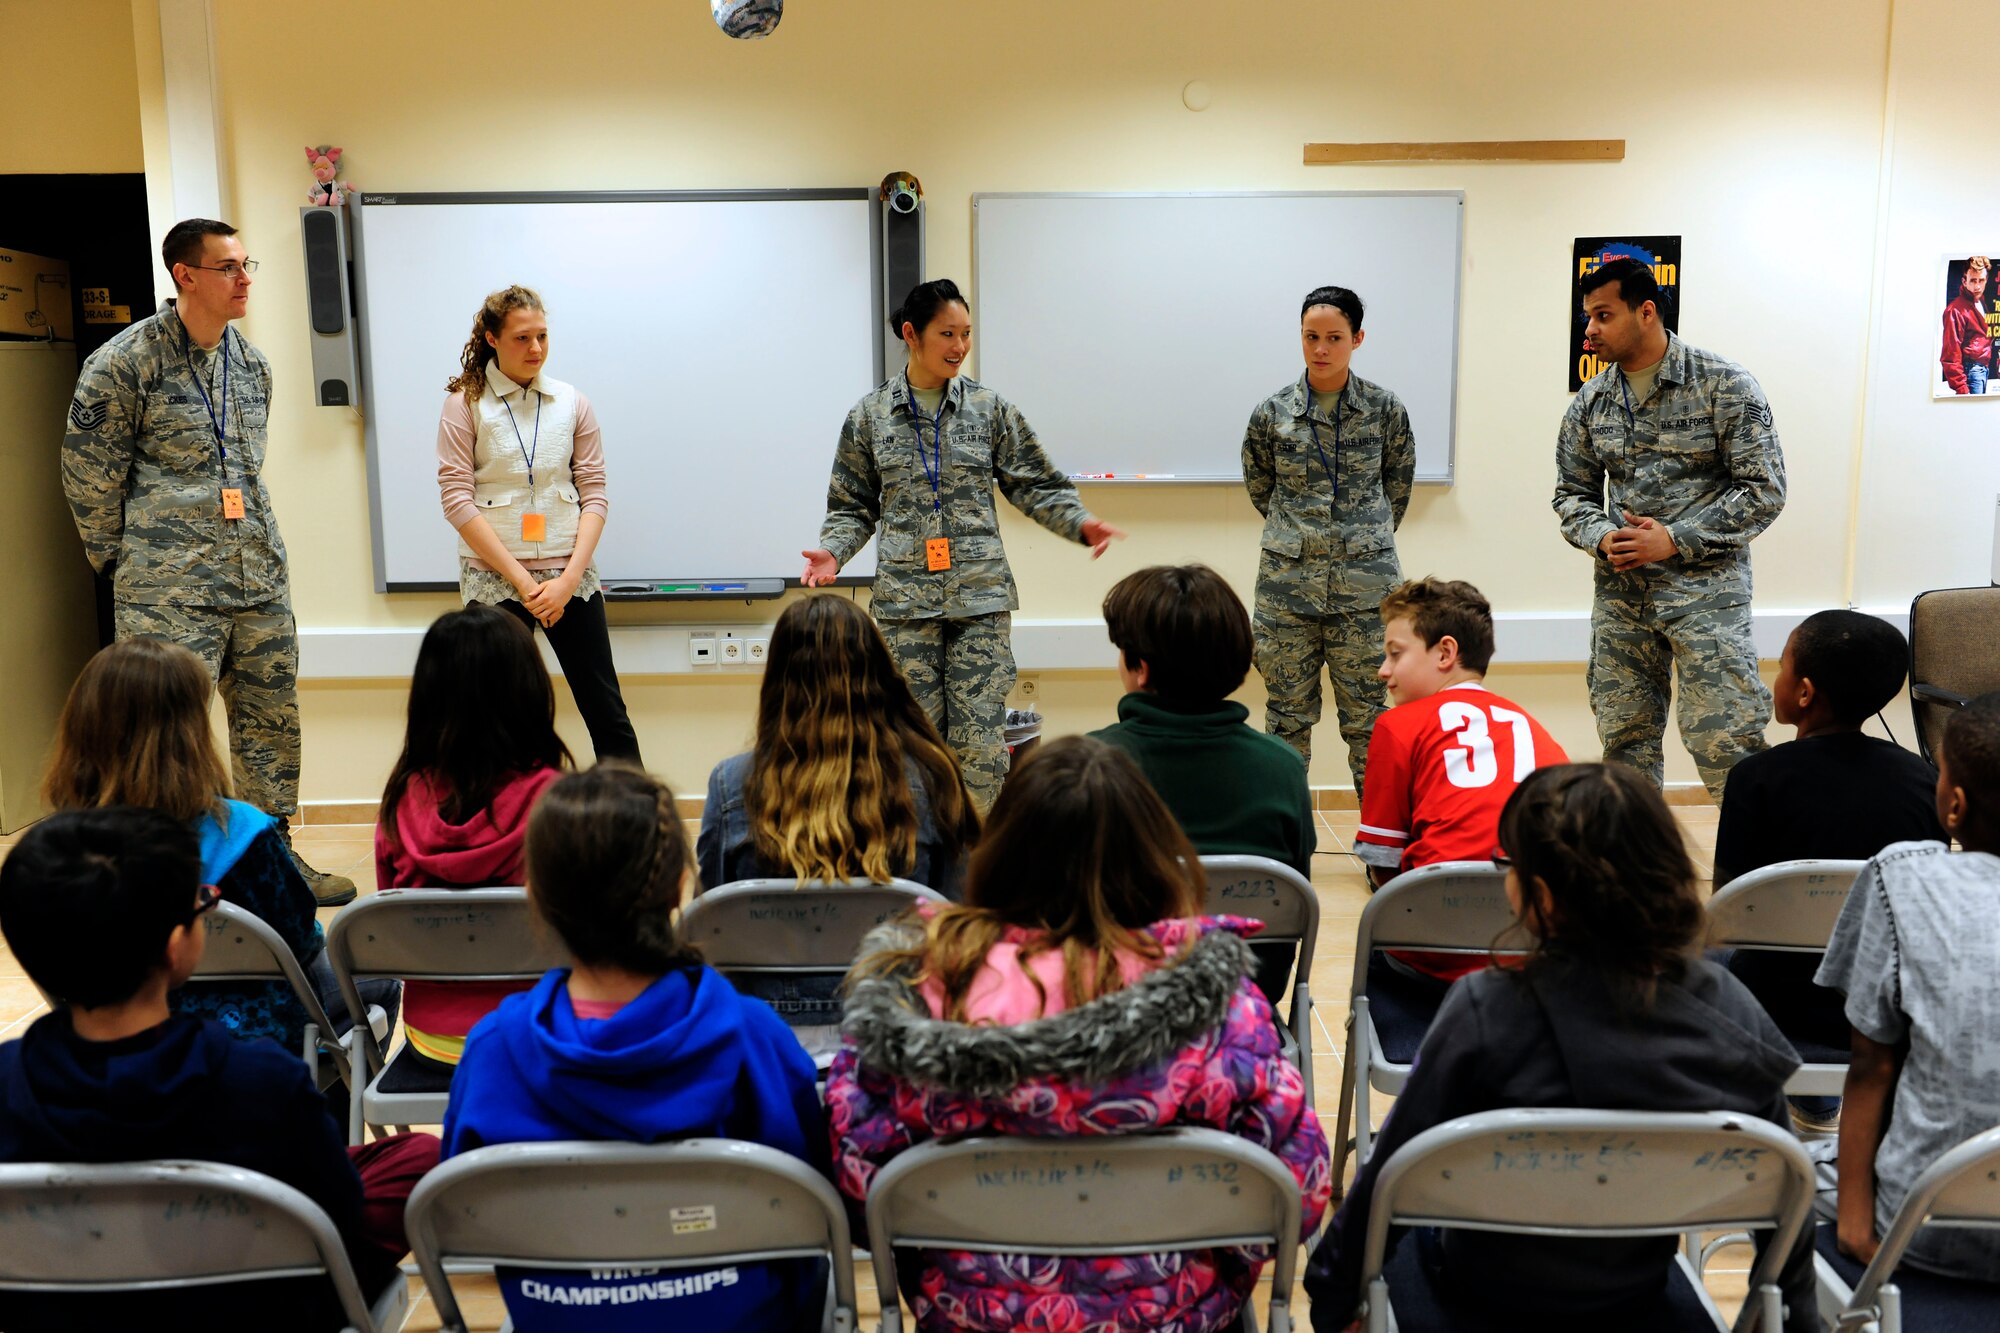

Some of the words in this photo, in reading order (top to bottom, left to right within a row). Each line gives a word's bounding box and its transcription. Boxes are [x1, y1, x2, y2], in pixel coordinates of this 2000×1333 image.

[1661, 421, 1674, 430] U.S.
[1676, 419, 1688, 429] AIR
[1689, 416, 1714, 427] FORCE
[967, 434, 977, 442] AIR
[1438, 701, 1536, 788] 37
[520, 1267, 740, 1305] CHAMPIONSHIPS
